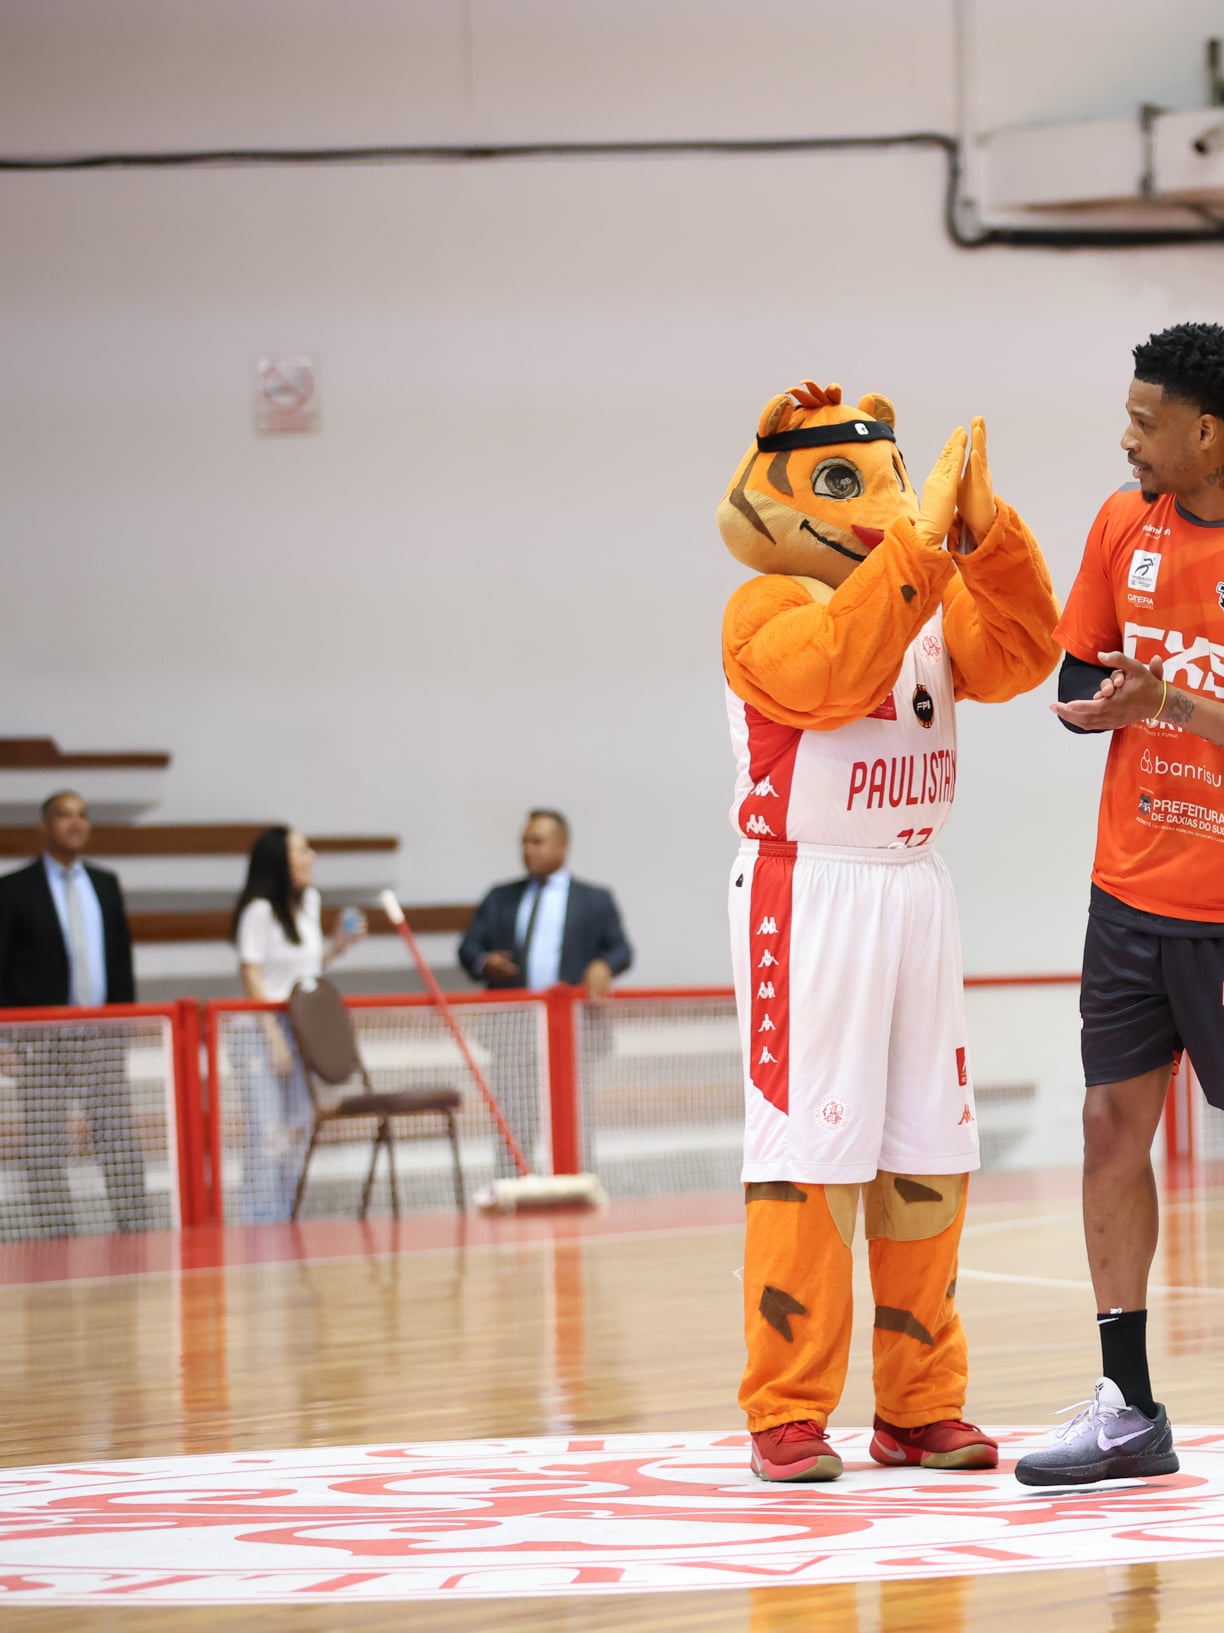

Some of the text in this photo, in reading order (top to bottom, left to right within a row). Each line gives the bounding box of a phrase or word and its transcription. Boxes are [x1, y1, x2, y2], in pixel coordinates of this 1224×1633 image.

[1151, 812, 1165, 822] DE
[1166, 814, 1198, 829] CAXIAS
[1199, 821, 1212, 832] DO
